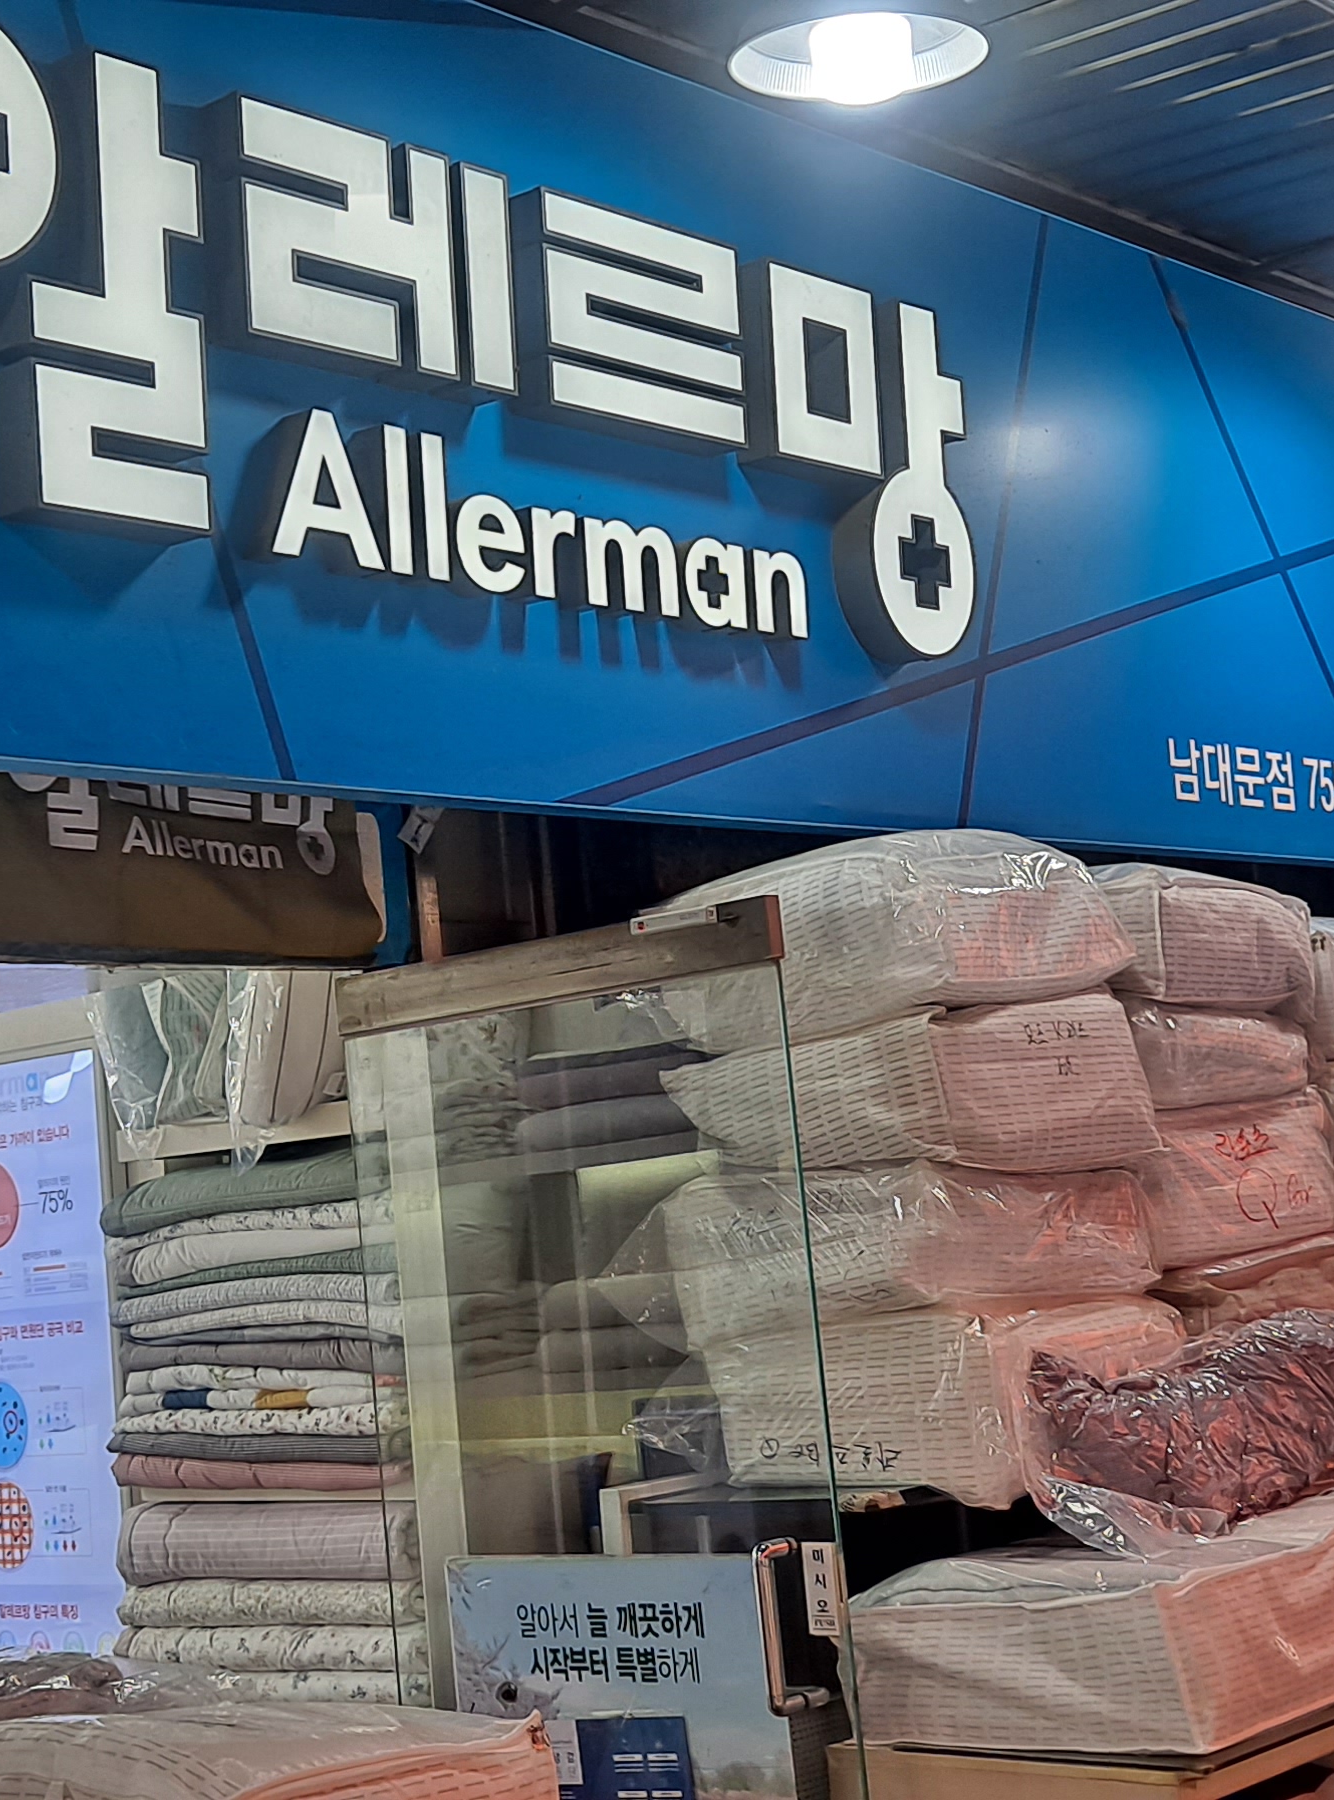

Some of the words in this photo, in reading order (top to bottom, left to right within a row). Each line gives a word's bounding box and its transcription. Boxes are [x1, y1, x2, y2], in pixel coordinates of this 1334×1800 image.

[271, 406, 810, 641] Allerman
[1167, 737, 1297, 812] 남대문점
[121, 815, 284, 871] Allerman
[36, 1123, 70, 1143] 있습니다
[38, 1188, 74, 1215] 75%
[65, 1319, 84, 1334] 비교
[516, 1602, 580, 1639] 알아서
[586, 1602, 609, 1639] 늘
[615, 1601, 706, 1639] 깨끗하게
[530, 1645, 611, 1684] 시작부터
[615, 1645, 702, 1684] 특별하게
